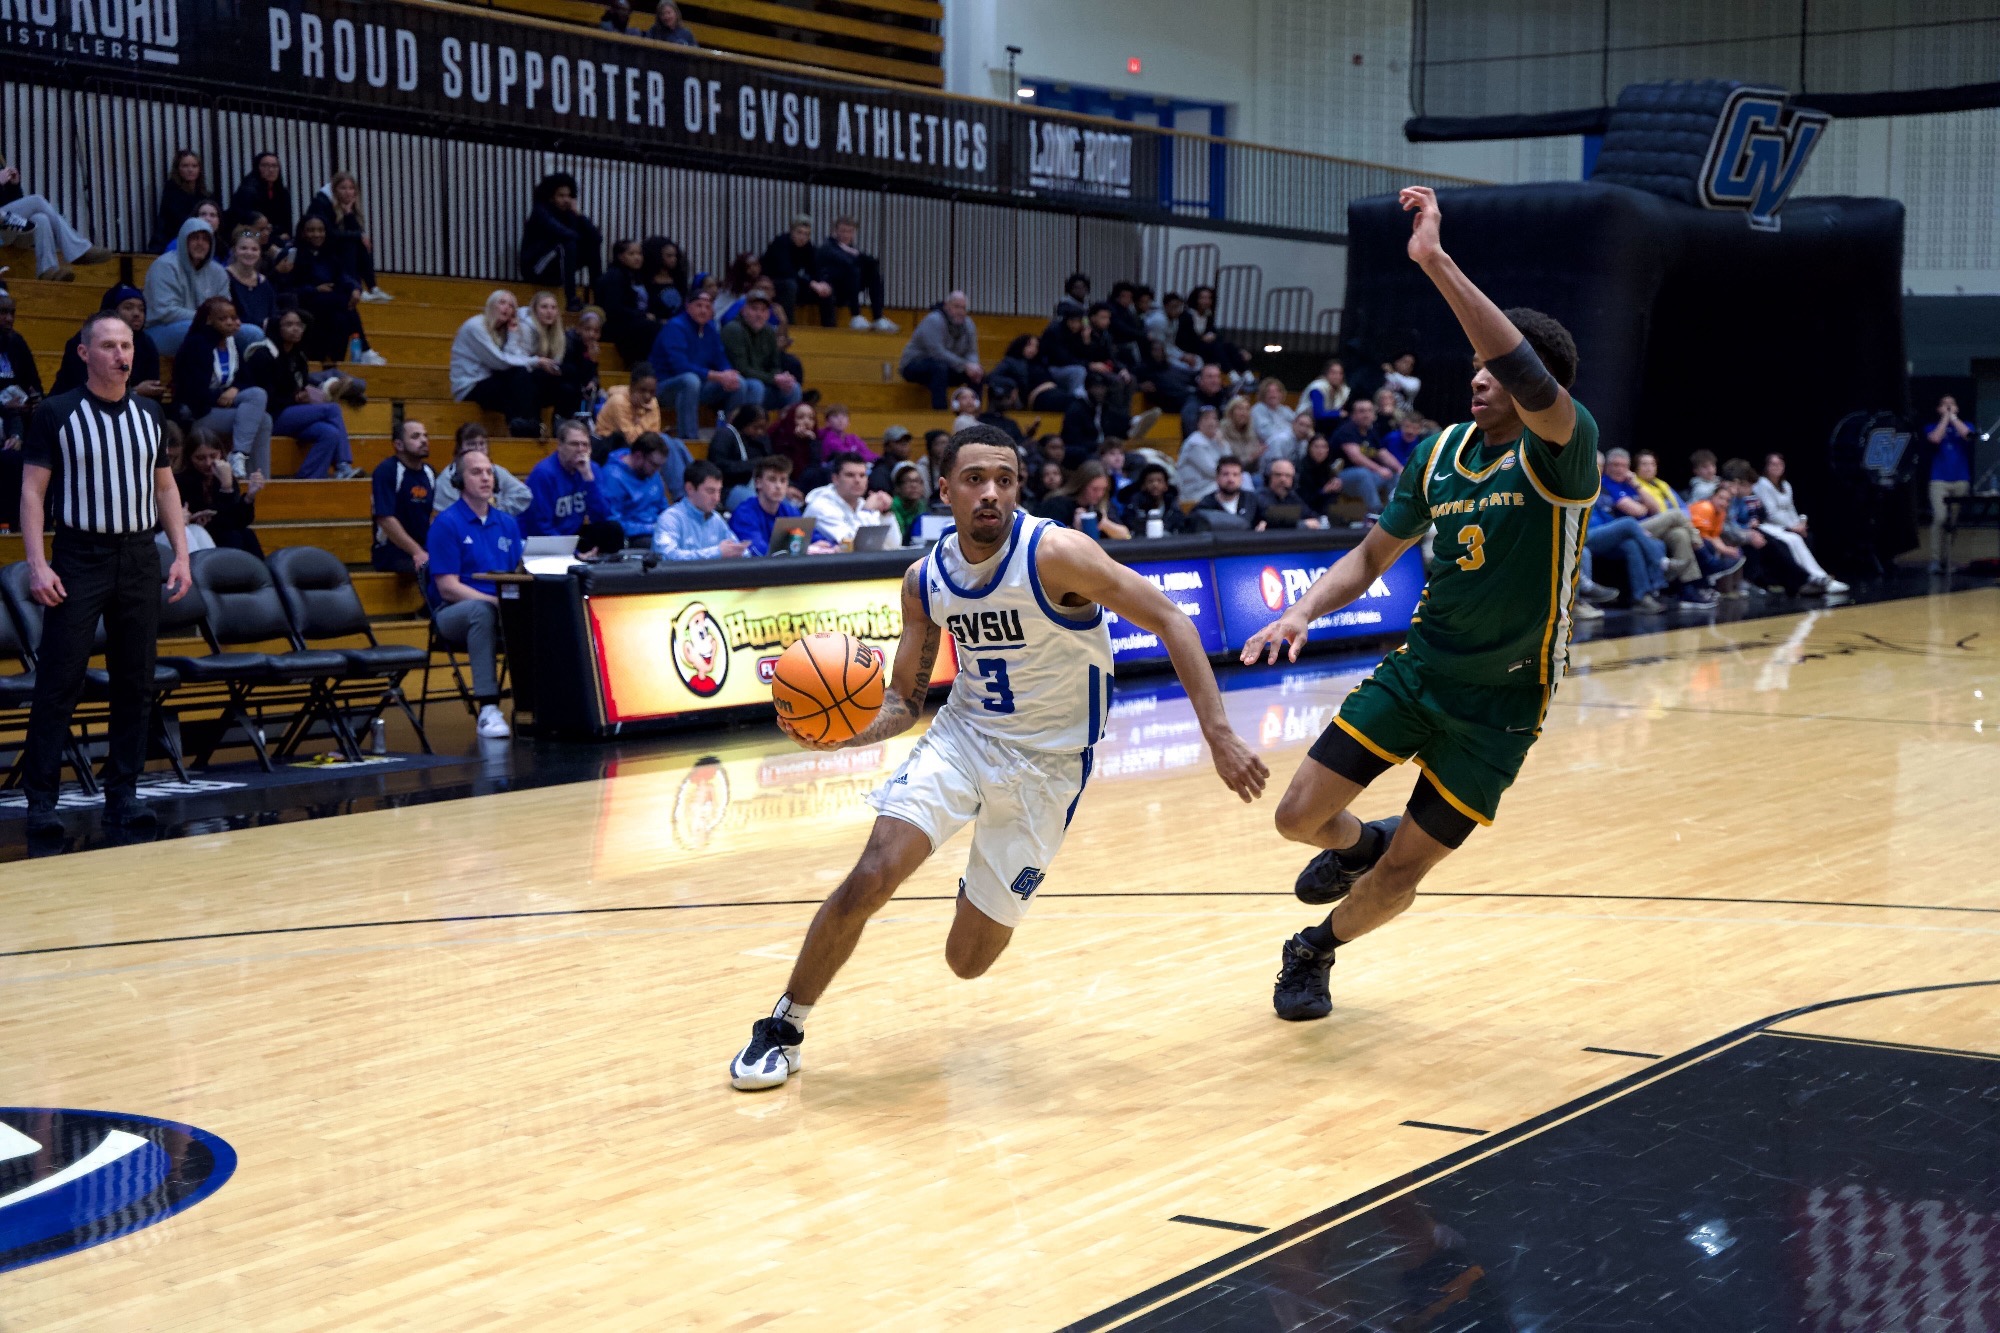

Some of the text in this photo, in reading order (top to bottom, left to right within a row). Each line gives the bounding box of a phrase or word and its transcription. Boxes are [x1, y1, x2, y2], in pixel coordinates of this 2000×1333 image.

[267, 7, 988, 172] PROUD SUPPORTER OF GVSU ATHLETICS
[555, 490, 588, 518] GVS
[1456, 524, 1486, 572] 3
[724, 610, 816, 651] Hungry
[945, 608, 1026, 645] GVSU
[975, 656, 1016, 714] 3
[1010, 866, 1047, 901] GV
